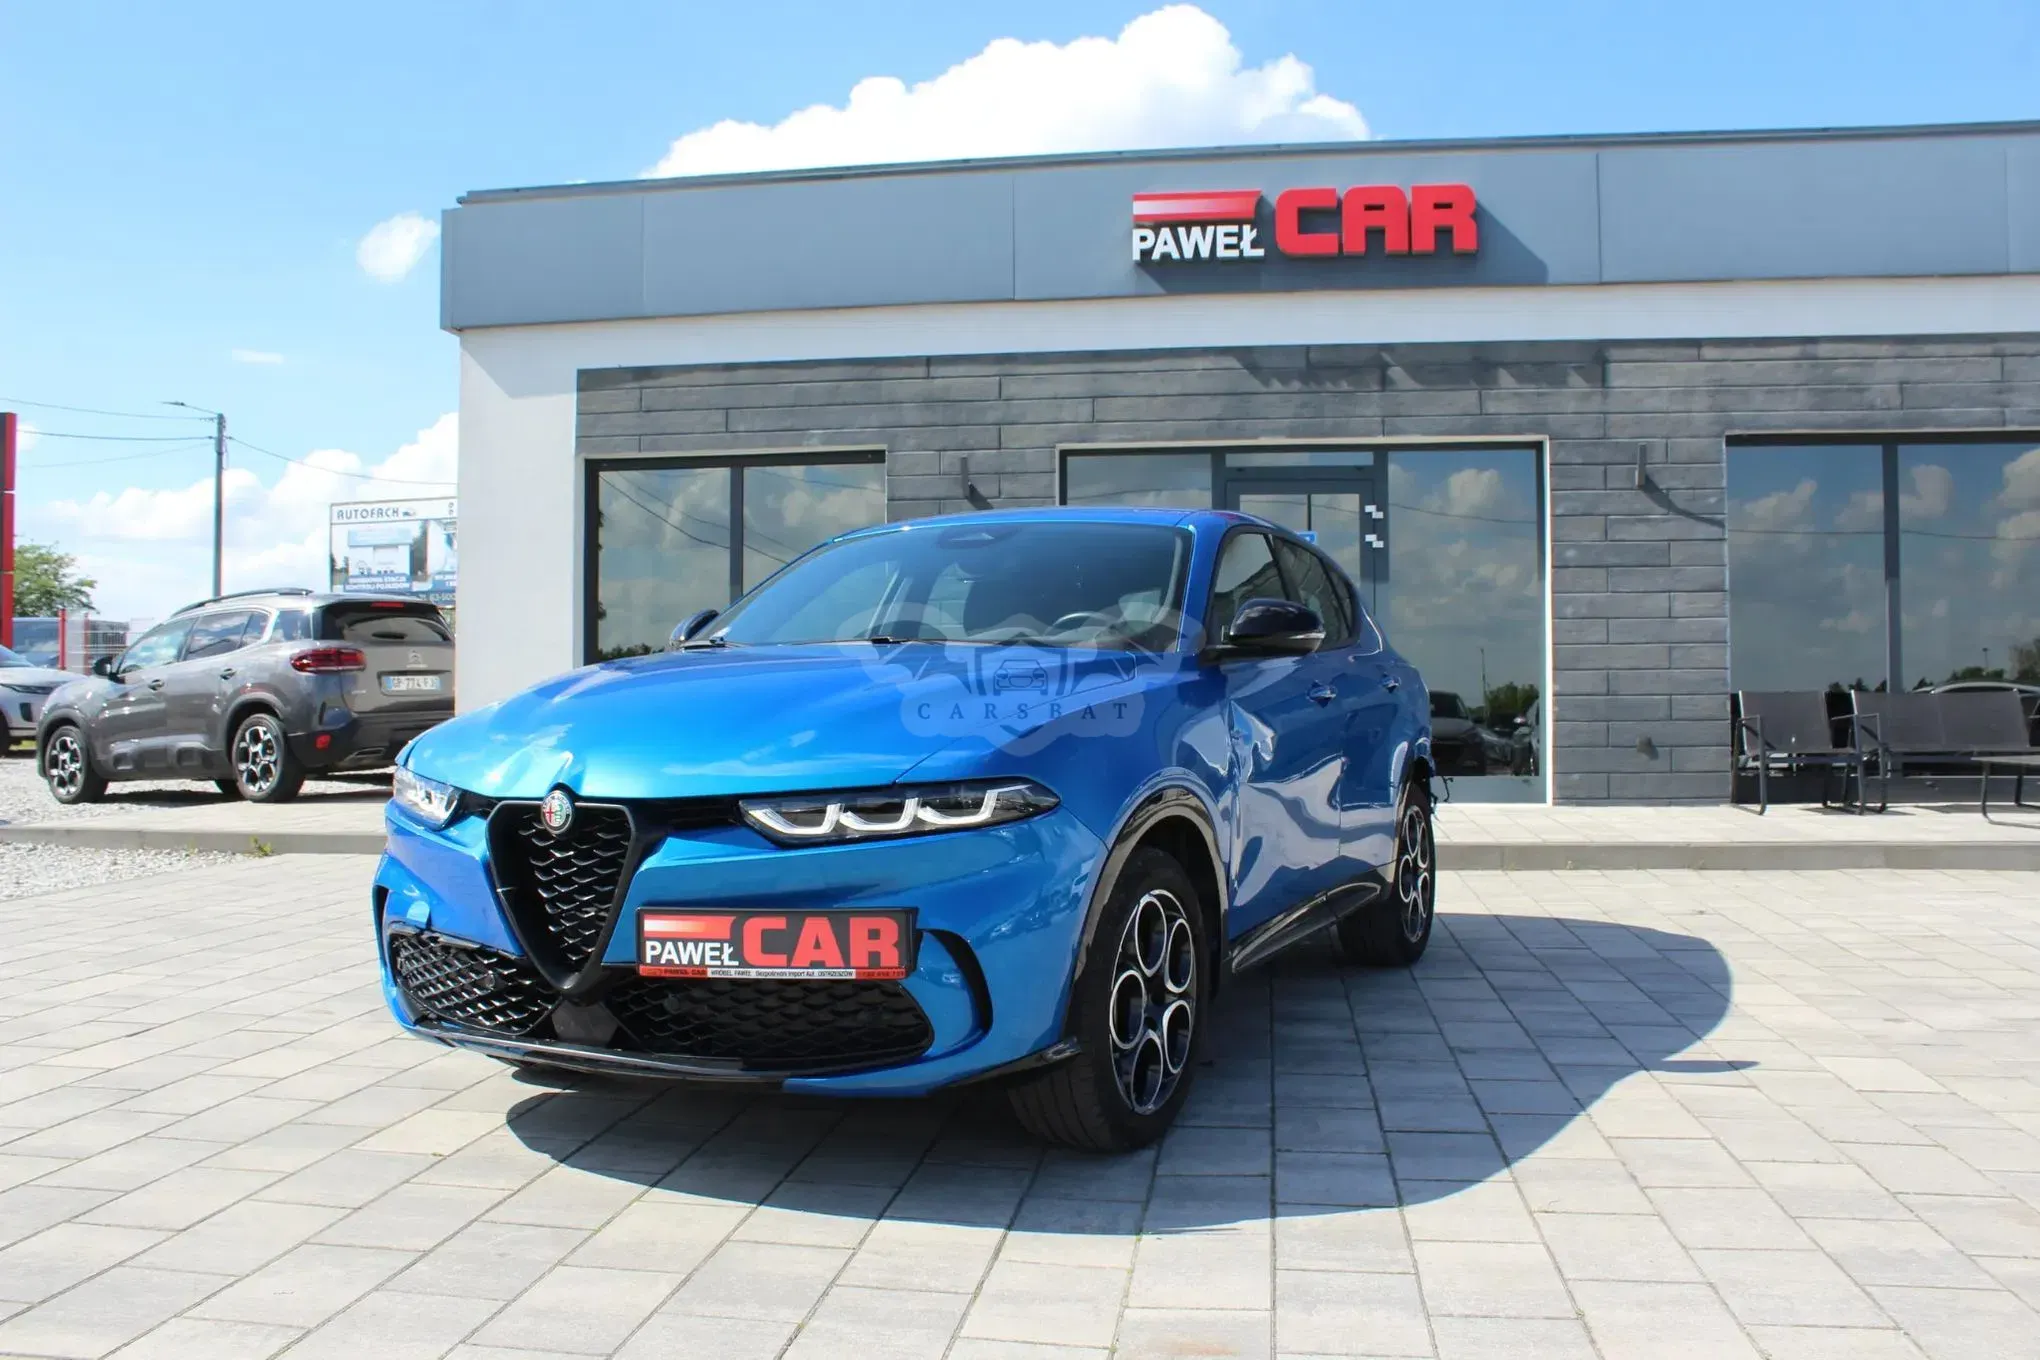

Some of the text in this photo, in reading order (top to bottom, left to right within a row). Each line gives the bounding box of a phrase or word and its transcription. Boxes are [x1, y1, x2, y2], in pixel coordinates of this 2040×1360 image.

[1132, 183, 1478, 261] PAWEŁ CAR
[645, 916, 900, 968] PAWEŁ CAR
